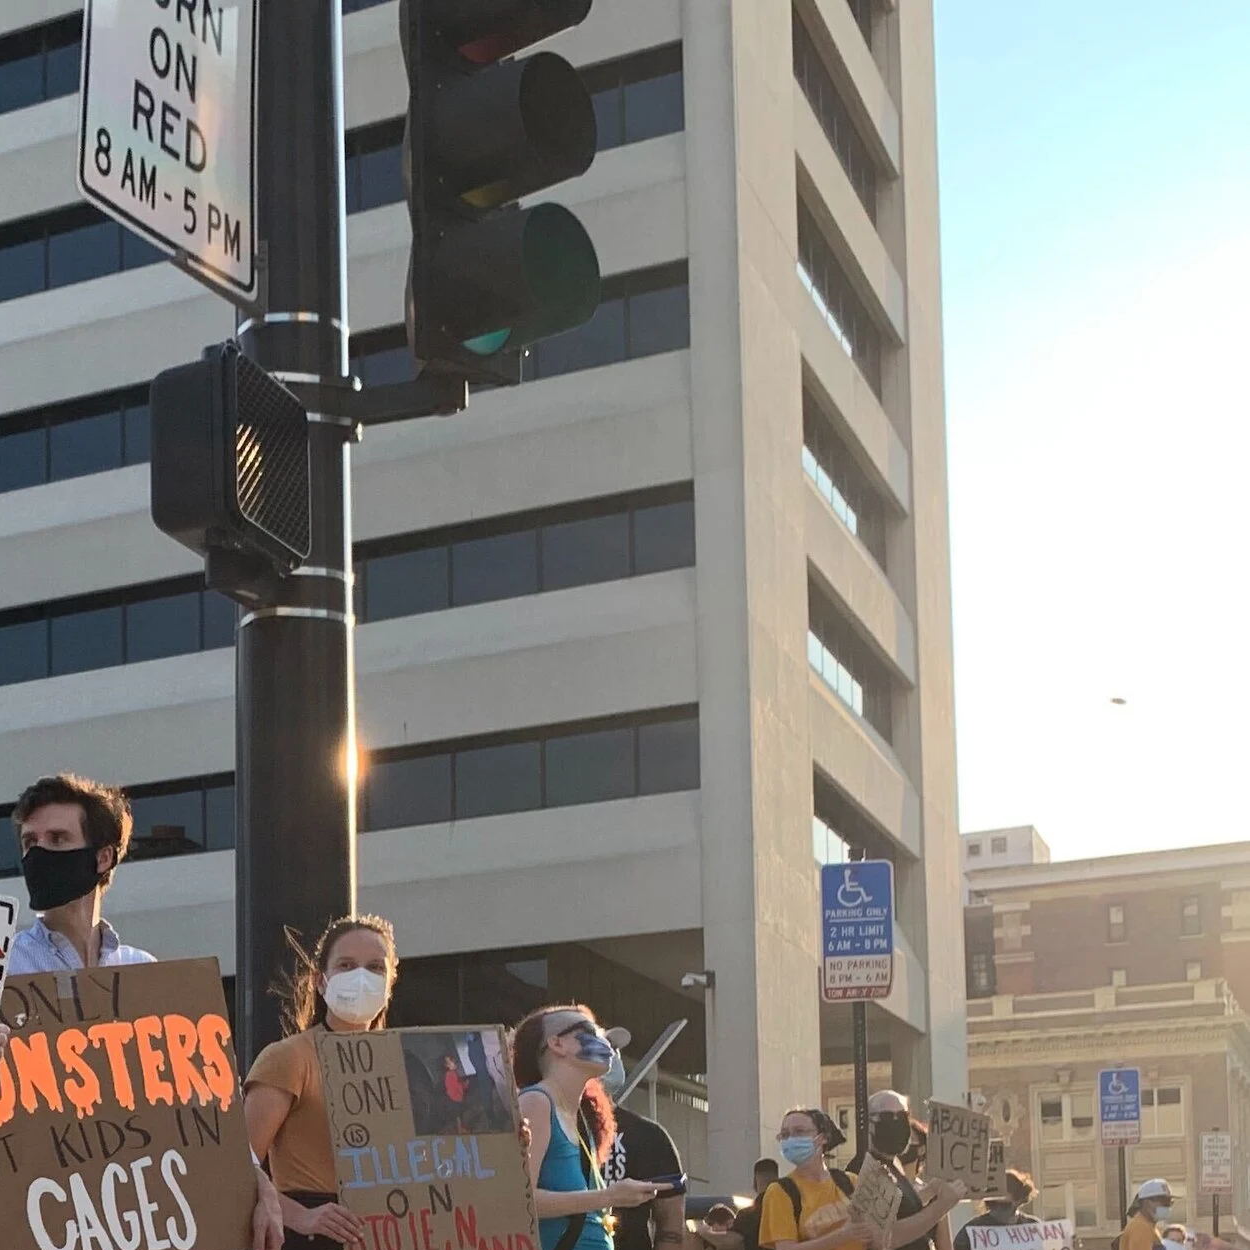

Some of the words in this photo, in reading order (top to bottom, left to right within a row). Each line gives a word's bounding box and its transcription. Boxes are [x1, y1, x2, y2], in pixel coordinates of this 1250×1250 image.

[156, 0, 224, 56] RN
[150, 26, 197, 104] ON
[132, 79, 207, 174] RED
[94, 127, 112, 177] 8
[120, 147, 157, 210] AM
[183, 187, 197, 235] 5
[207, 203, 241, 263] PM
[825, 907, 863, 919] PARKING
[866, 906, 889, 918] ONLY
[828, 941, 835, 952] 6
[837, 940, 851, 951] AM
[864, 939, 871, 950] 8
[873, 938, 888, 949] PM
[830, 926, 838, 939] 2
[841, 926, 855, 938] HR
[859, 924, 885, 937] LIMIT
[830, 961, 843, 972] NO
[847, 959, 888, 971] PARKING
[830, 973, 836, 984] 8
[838, 972, 853, 984] PM
[865, 972, 872, 983] 6
[875, 971, 888, 982] AM
[0, 971, 121, 1030] ONLY
[336, 1039, 374, 1075] NO
[342, 1074, 402, 1116] ONE
[49, 1113, 152, 1169] KIDS
[173, 1106, 221, 1149] IN
[931, 1106, 989, 1142] ABOLISH
[614, 1131, 627, 1154] K
[940, 1137, 983, 1174] ICE
[338, 1134, 495, 1189] ILLEGAL
[604, 1153, 627, 1180] ES
[386, 1183, 453, 1219] ON
[972, 1227, 1000, 1249] NO
[1006, 1222, 1066, 1245] HUMAN
